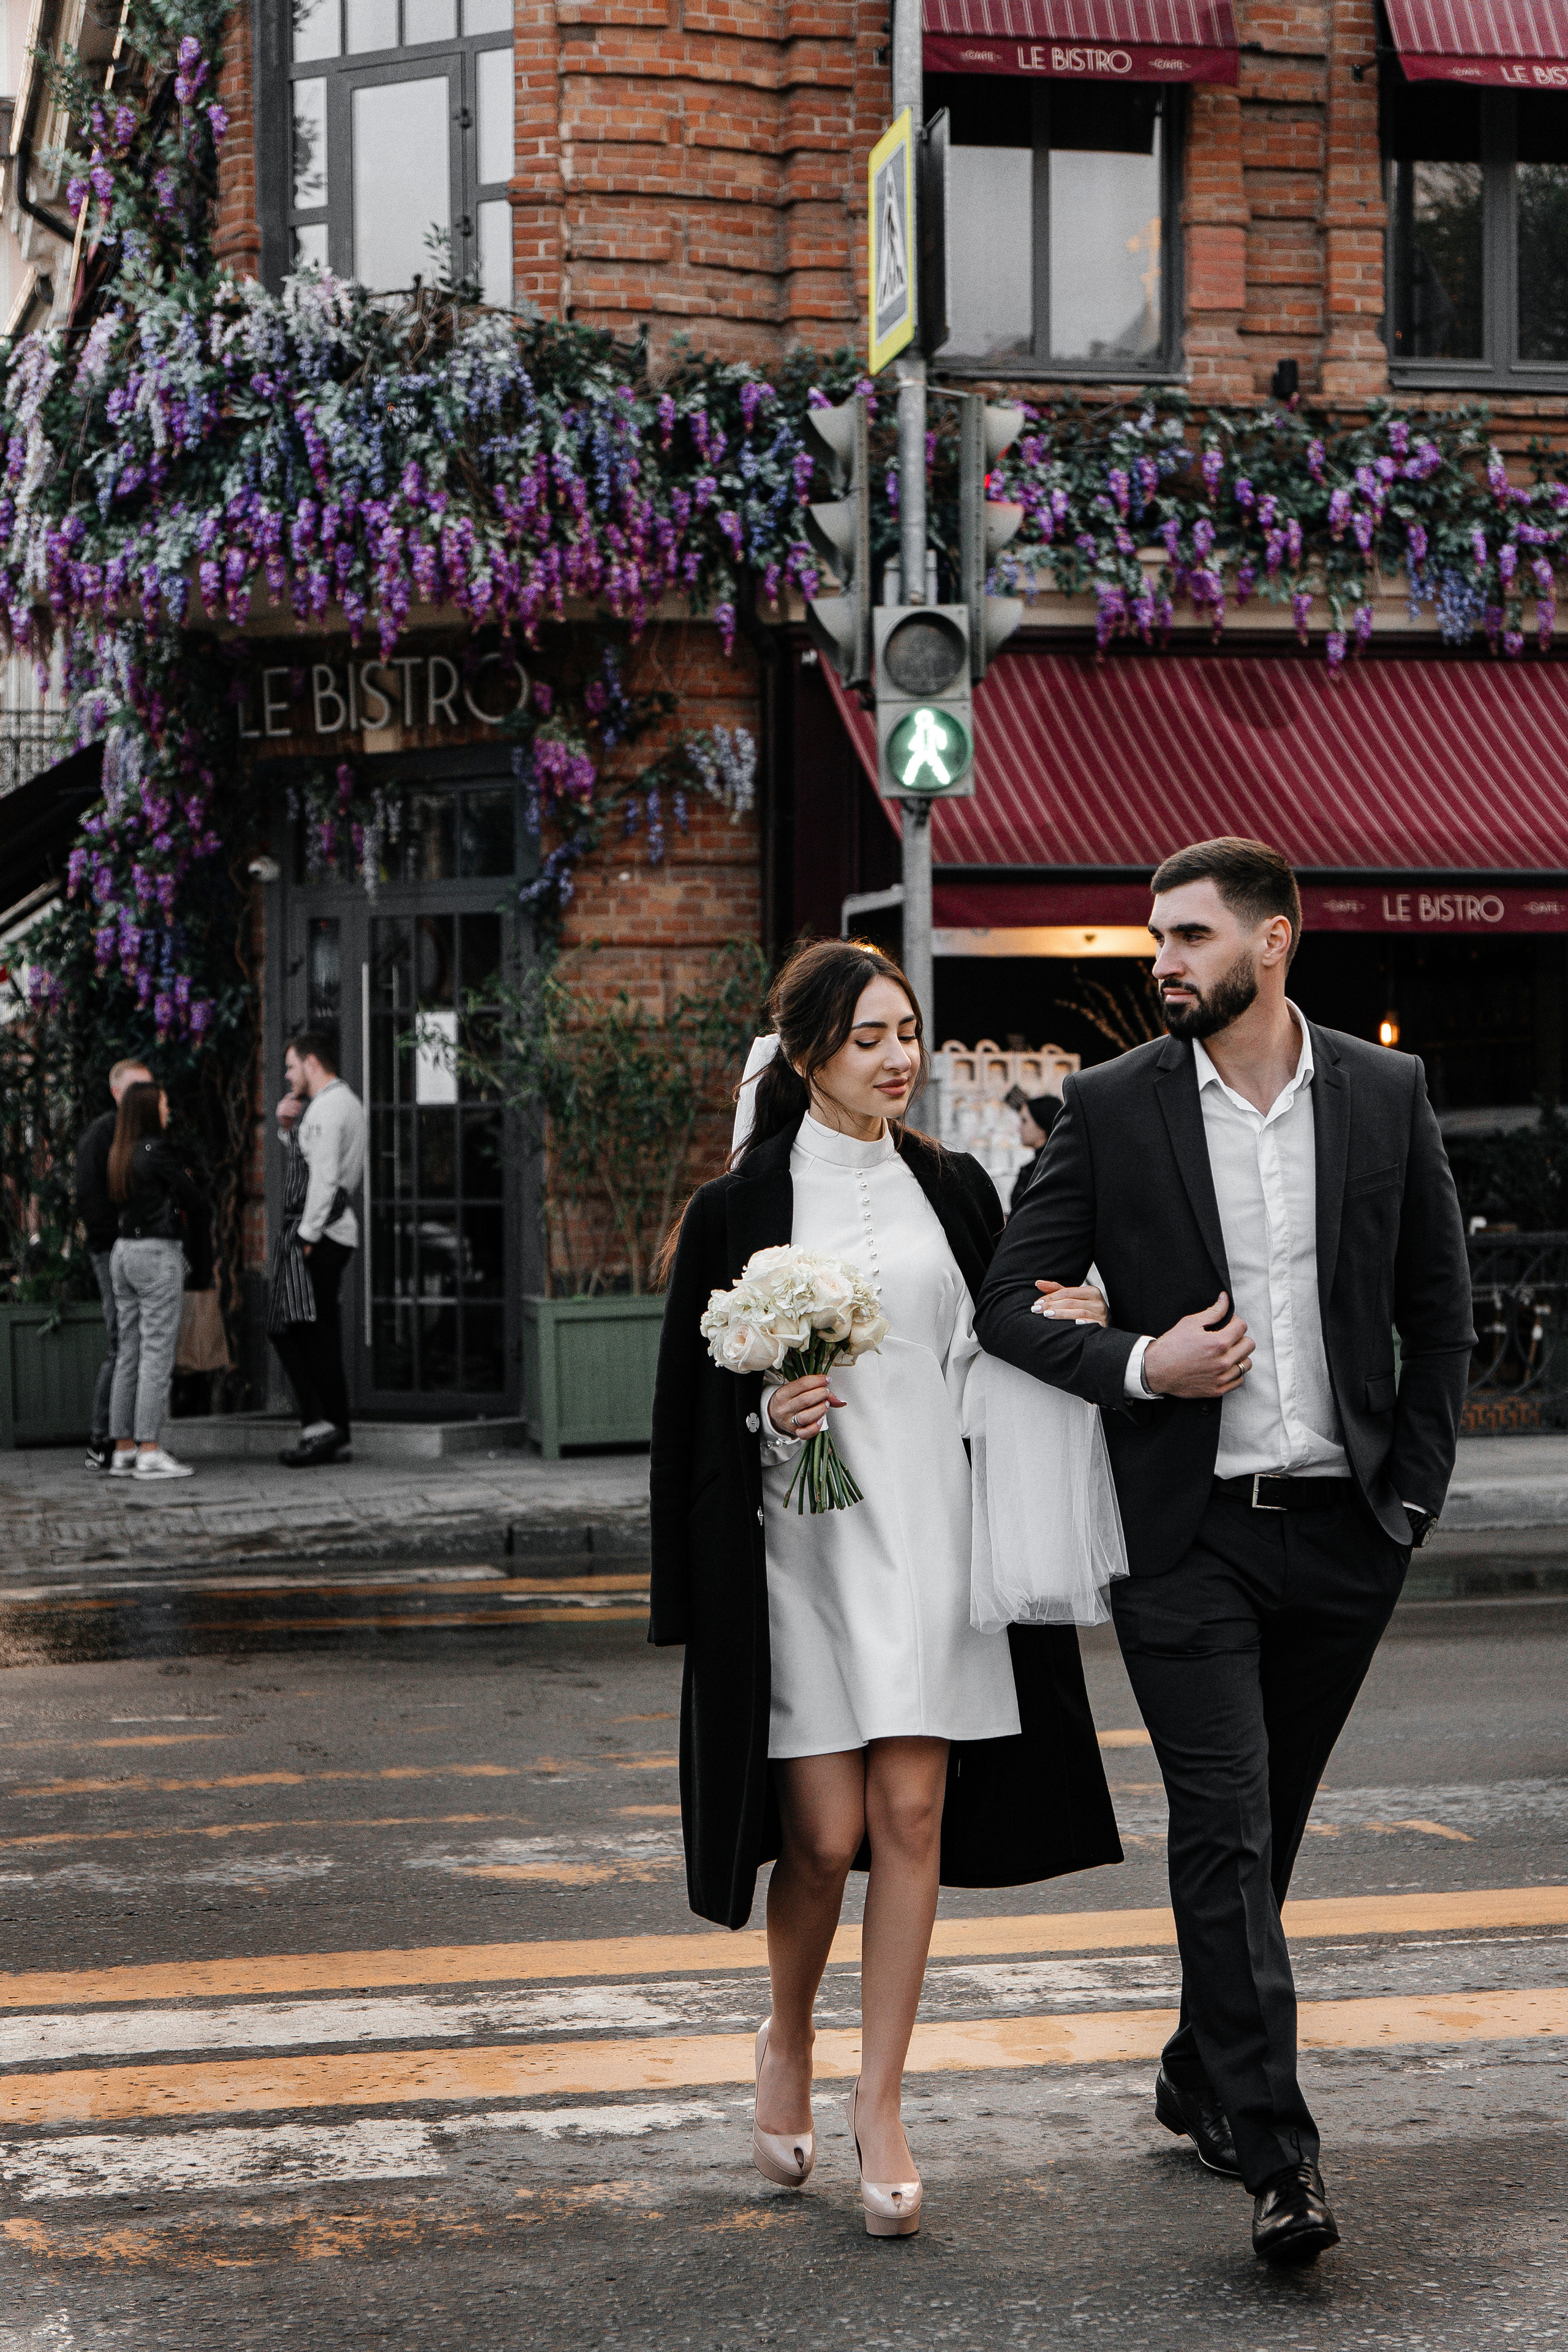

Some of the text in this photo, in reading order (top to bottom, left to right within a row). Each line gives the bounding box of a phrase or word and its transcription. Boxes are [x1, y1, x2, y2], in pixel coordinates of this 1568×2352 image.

[1017, 45, 1045, 69] LE
[1052, 47, 1133, 73] BISTRO
[1500, 65, 1531, 83] LE
[238, 654, 529, 737] LE BISTRO
[1382, 894, 1412, 921] LE
[1419, 894, 1504, 922] BISTRO
